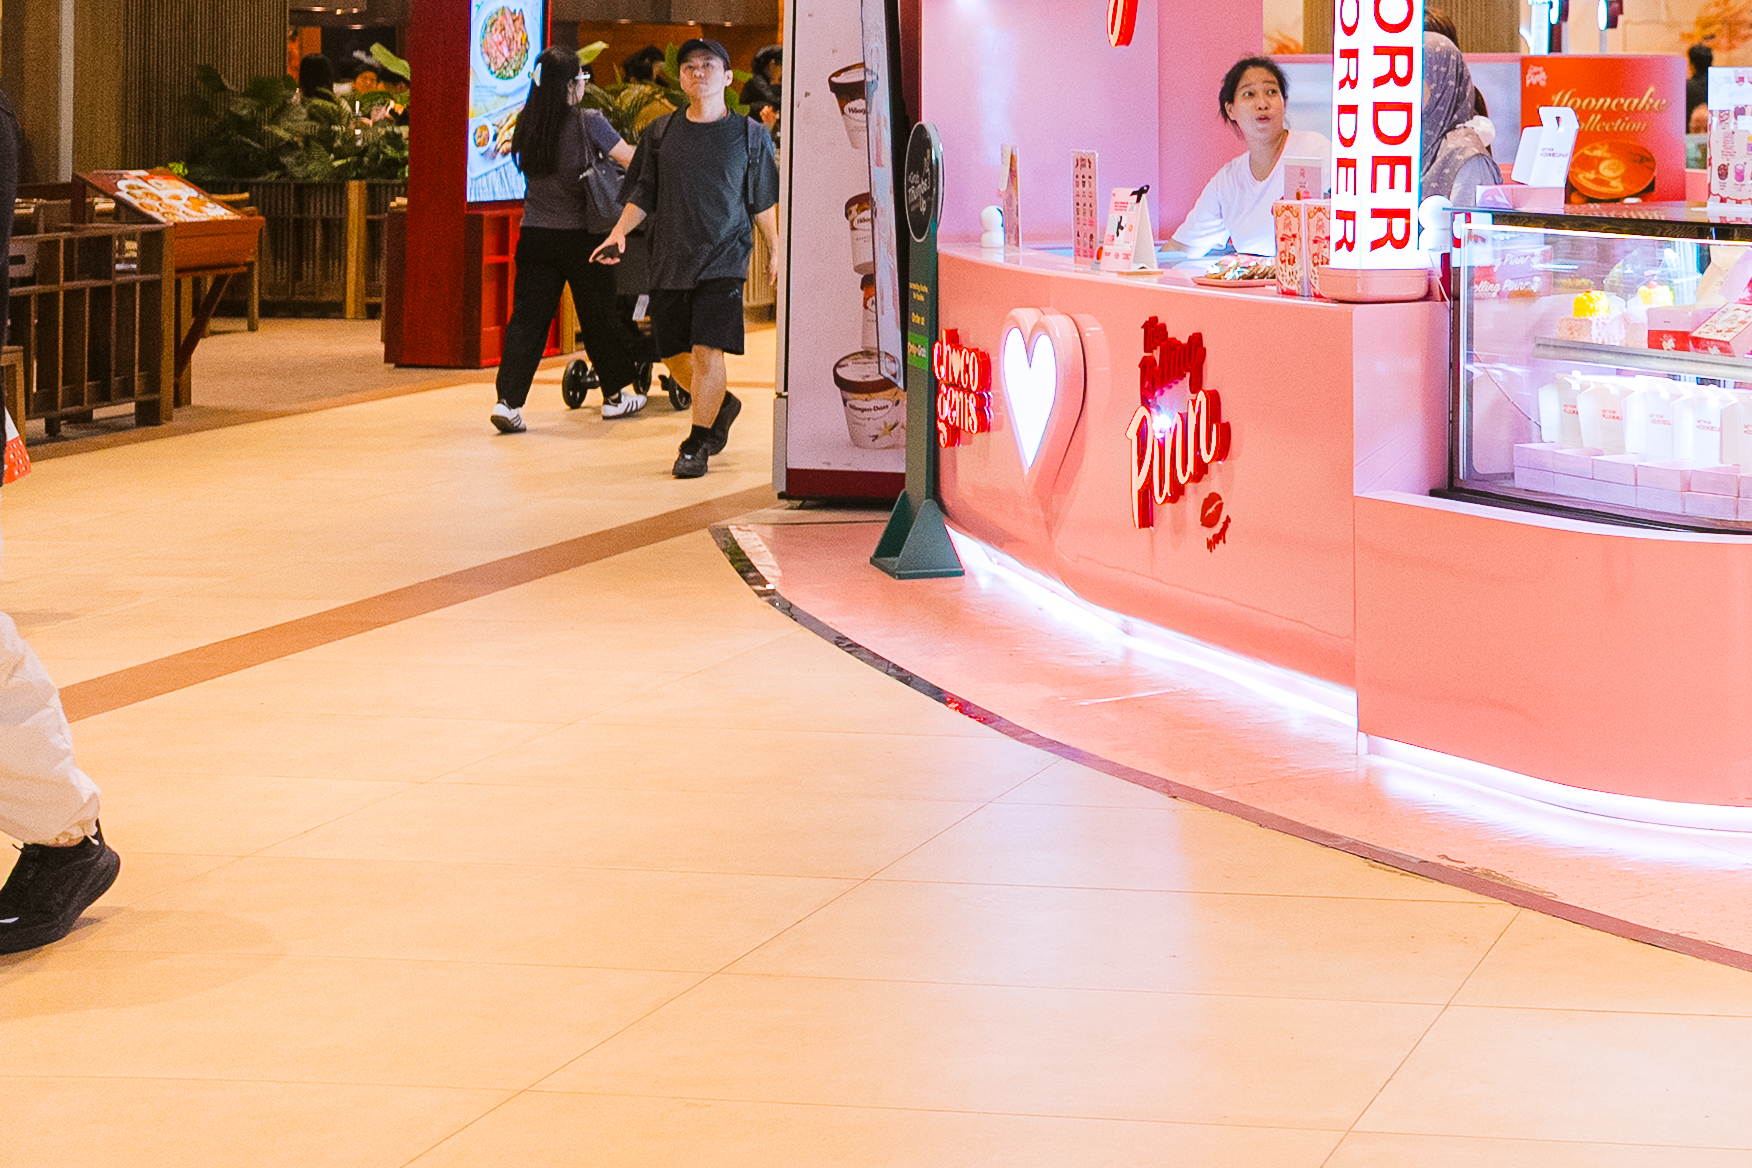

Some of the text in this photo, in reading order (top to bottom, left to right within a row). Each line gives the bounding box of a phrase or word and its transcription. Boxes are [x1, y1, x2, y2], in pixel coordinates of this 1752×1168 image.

[1537, 86, 1669, 112] Mooncake
[1579, 113, 1649, 132] ollection
[1125, 388, 1230, 529] Pinn
